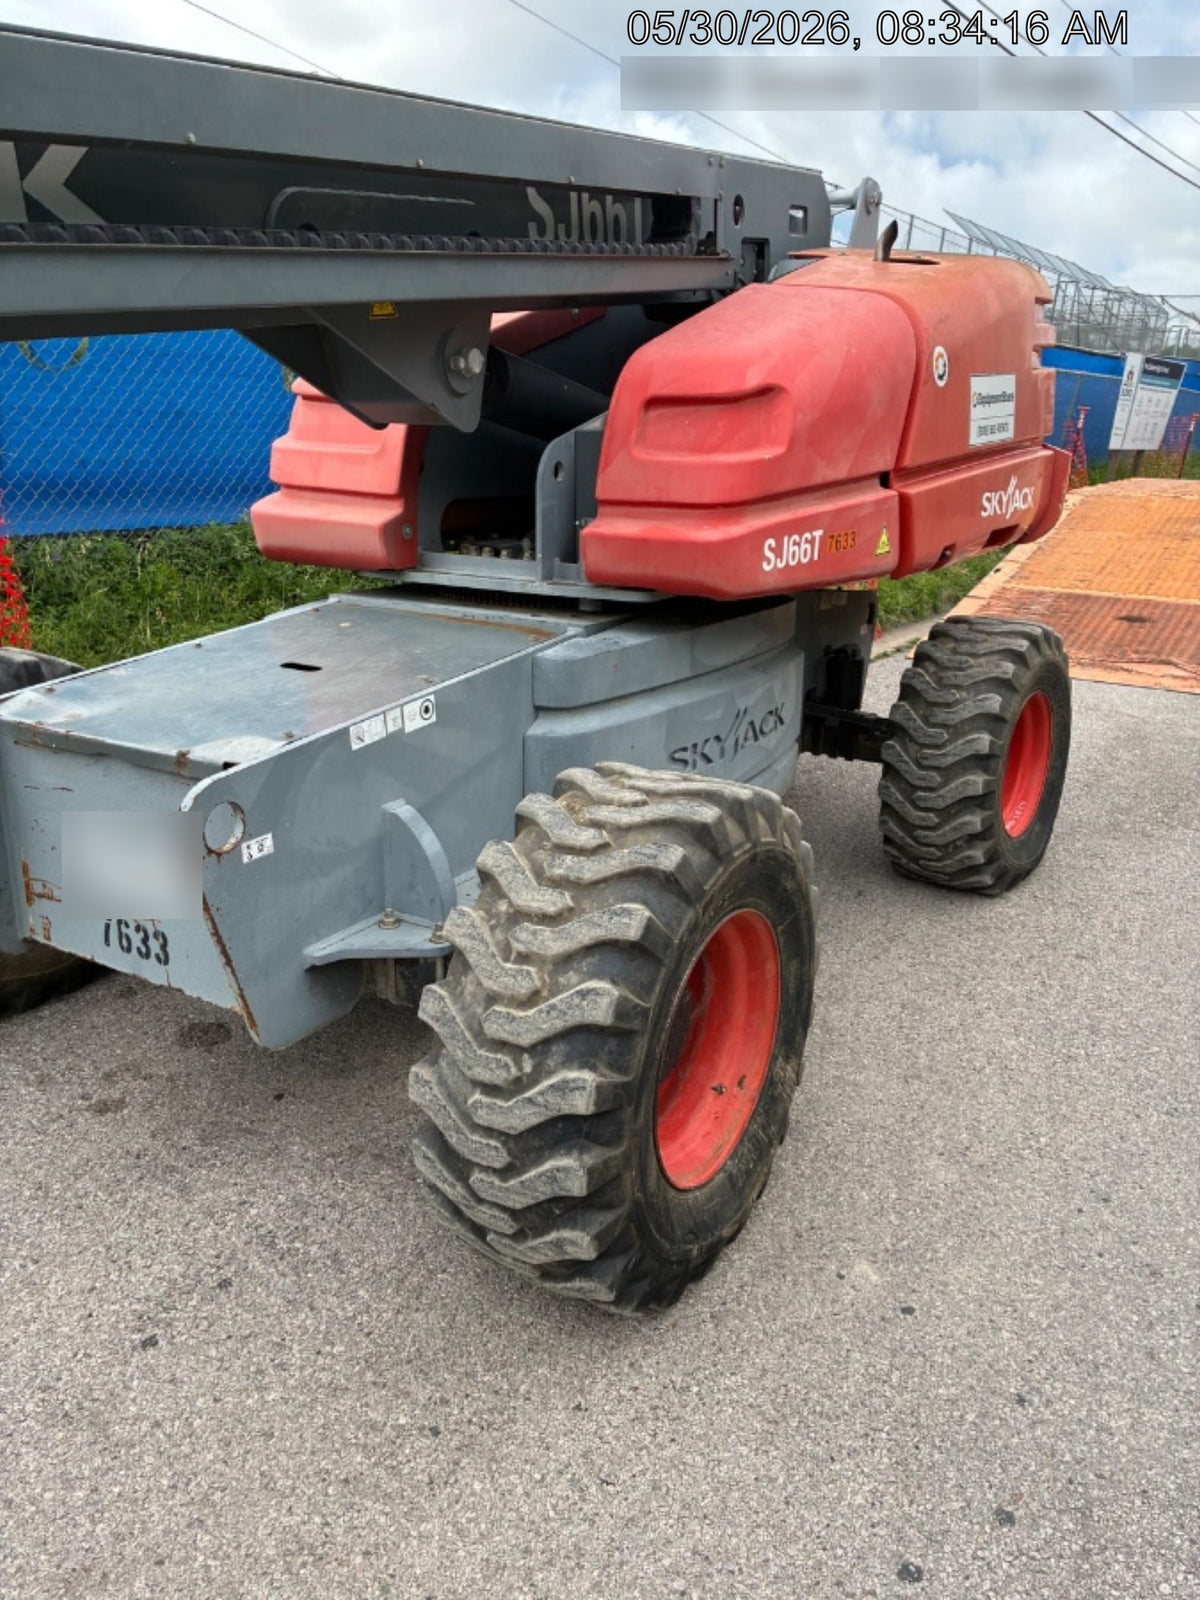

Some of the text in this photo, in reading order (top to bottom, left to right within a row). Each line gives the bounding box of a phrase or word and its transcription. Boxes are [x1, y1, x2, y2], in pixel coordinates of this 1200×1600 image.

[980, 475, 1035, 519] SKYJACK
[762, 529, 857, 571] SJ66T 7633
[668, 701, 785, 771] SKYJACK
